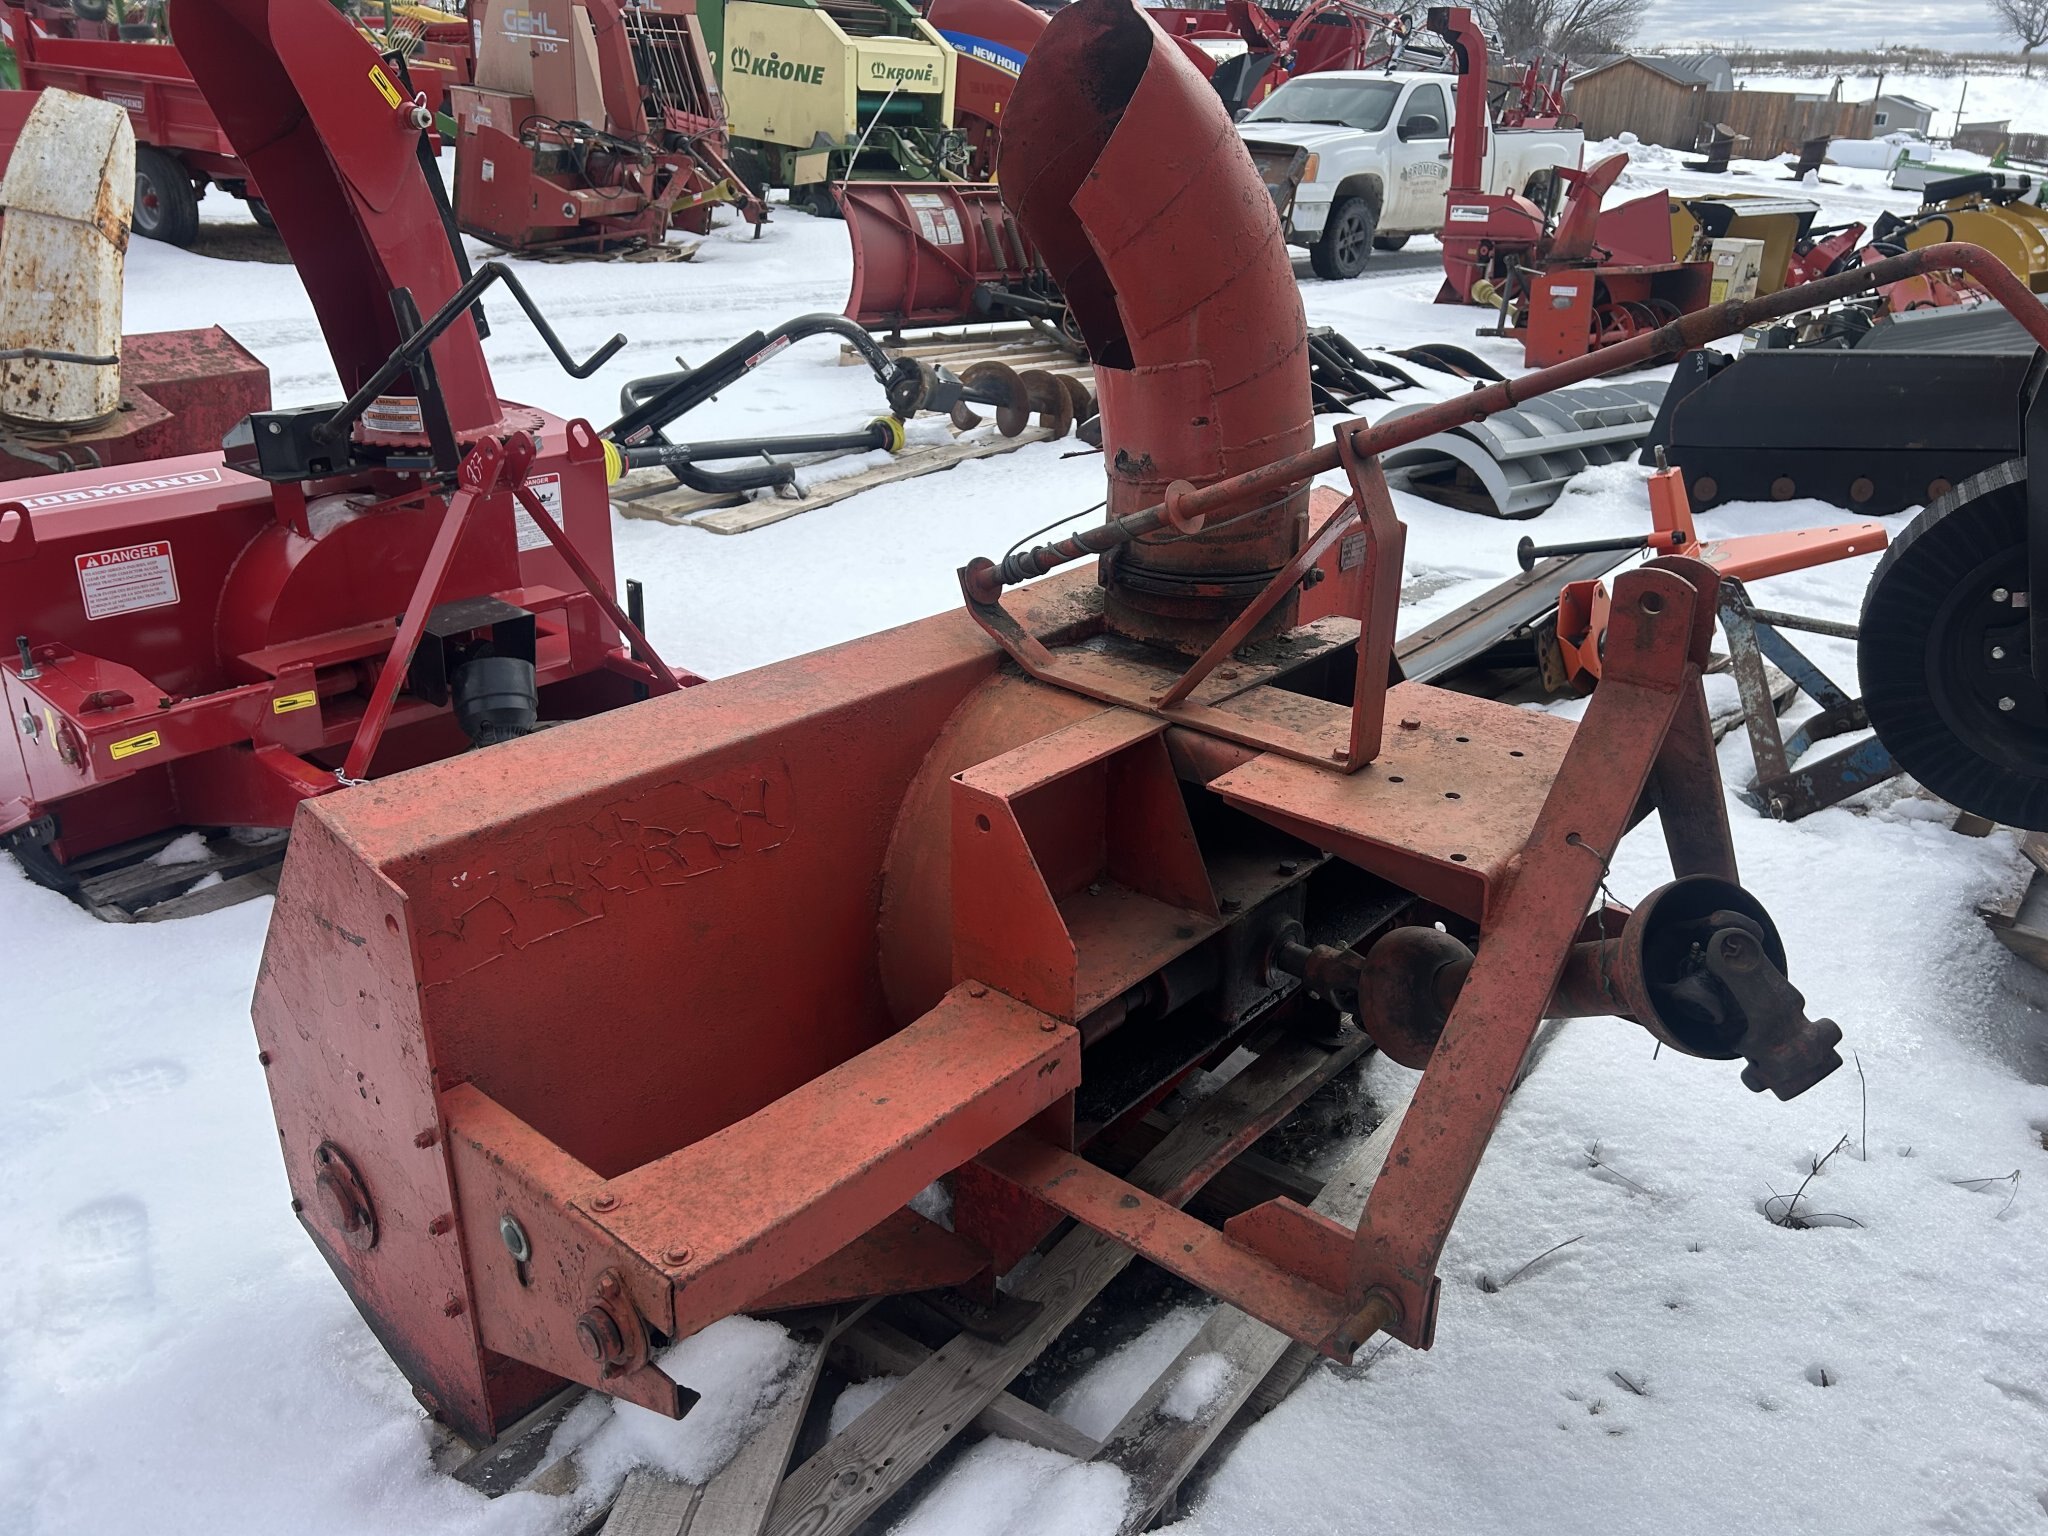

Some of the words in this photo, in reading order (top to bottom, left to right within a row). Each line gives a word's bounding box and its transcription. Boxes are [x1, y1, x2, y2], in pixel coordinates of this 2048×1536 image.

[502, 8, 558, 35] GEHL
[536, 41, 558, 53] TDC
[972, 45, 996, 62] NEW
[751, 57, 825, 85] KRONE
[886, 68, 932, 81] KRONE
[101, 546, 158, 565] DANGER
